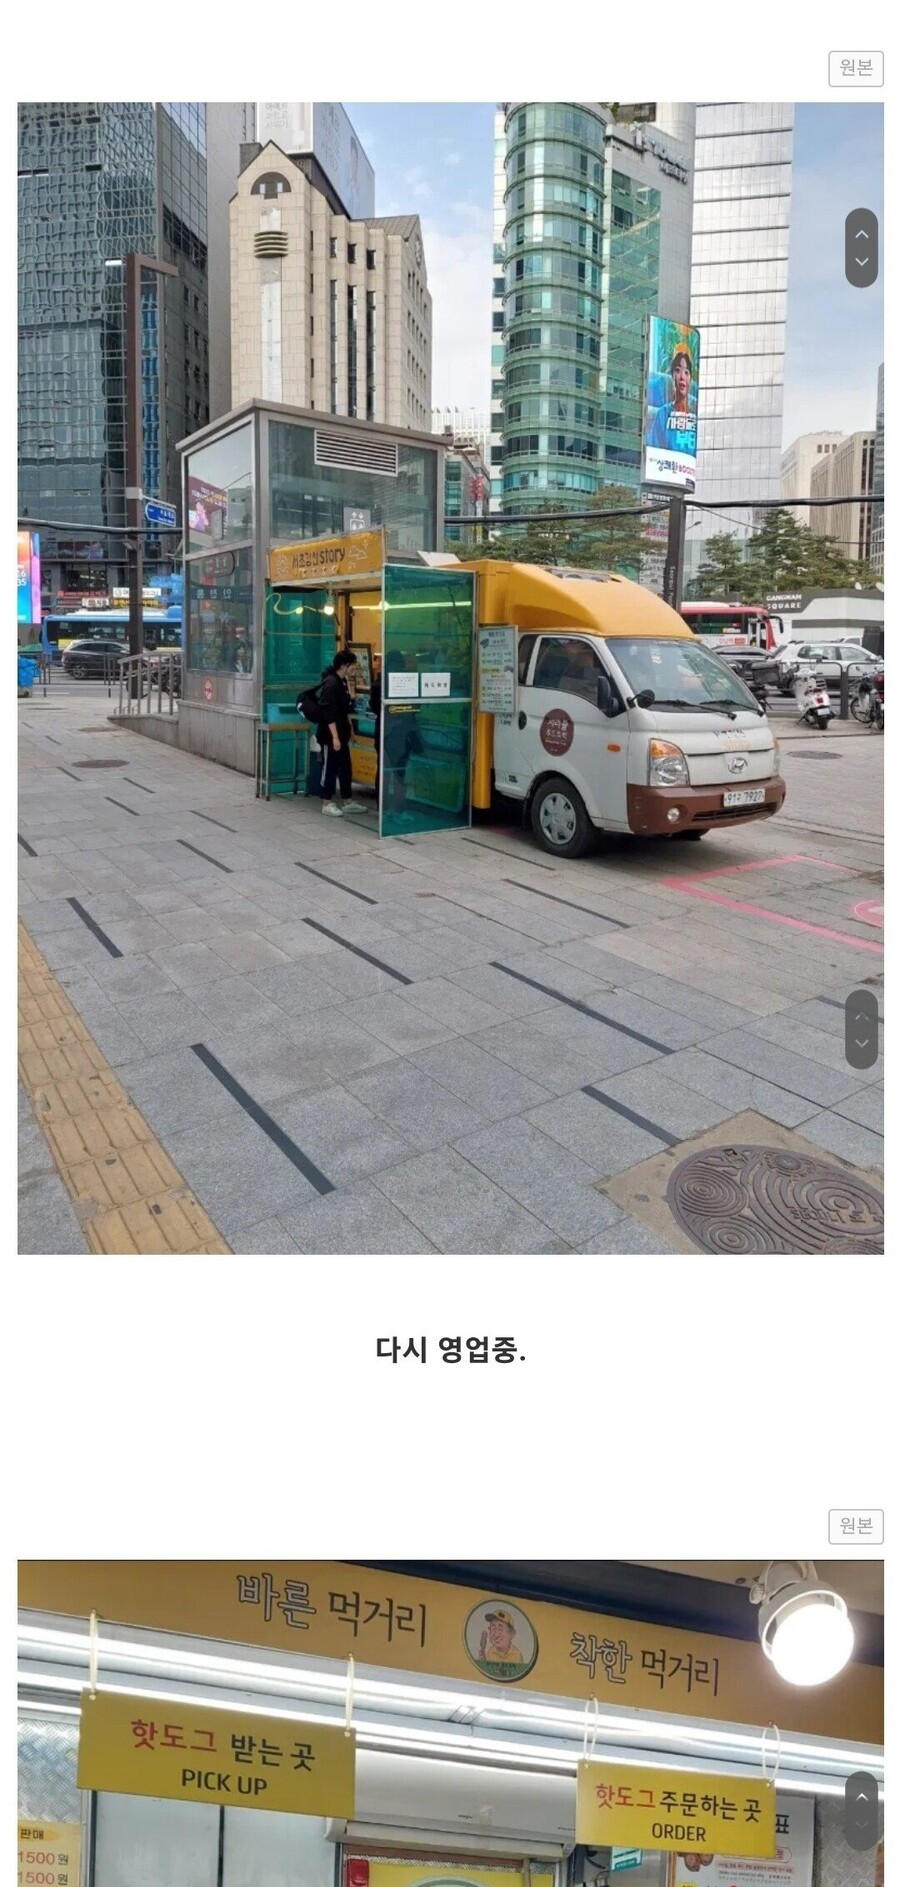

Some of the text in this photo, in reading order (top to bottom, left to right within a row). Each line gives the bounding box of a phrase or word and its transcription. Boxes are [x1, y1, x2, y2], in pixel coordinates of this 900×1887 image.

[766, 593, 802, 601] GANGNAM
[766, 602, 802, 610] SQUARE
[376, 1335, 526, 1364] 다시 영업중.
[236, 1571, 427, 1648] 바른 먹거리
[569, 1631, 720, 1697] 착한 먹거리
[130, 1718, 316, 1772] 핫도그 받는 곳
[181, 1768, 268, 1796] PICK UP
[595, 1783, 762, 1824] 핫도그 주문하는 곳
[20, 1828, 44, 1841] 판매
[651, 1822, 707, 1843] ORDER
[57, 1853, 69, 1866] 원
[57, 1873, 68, 1886] 원
